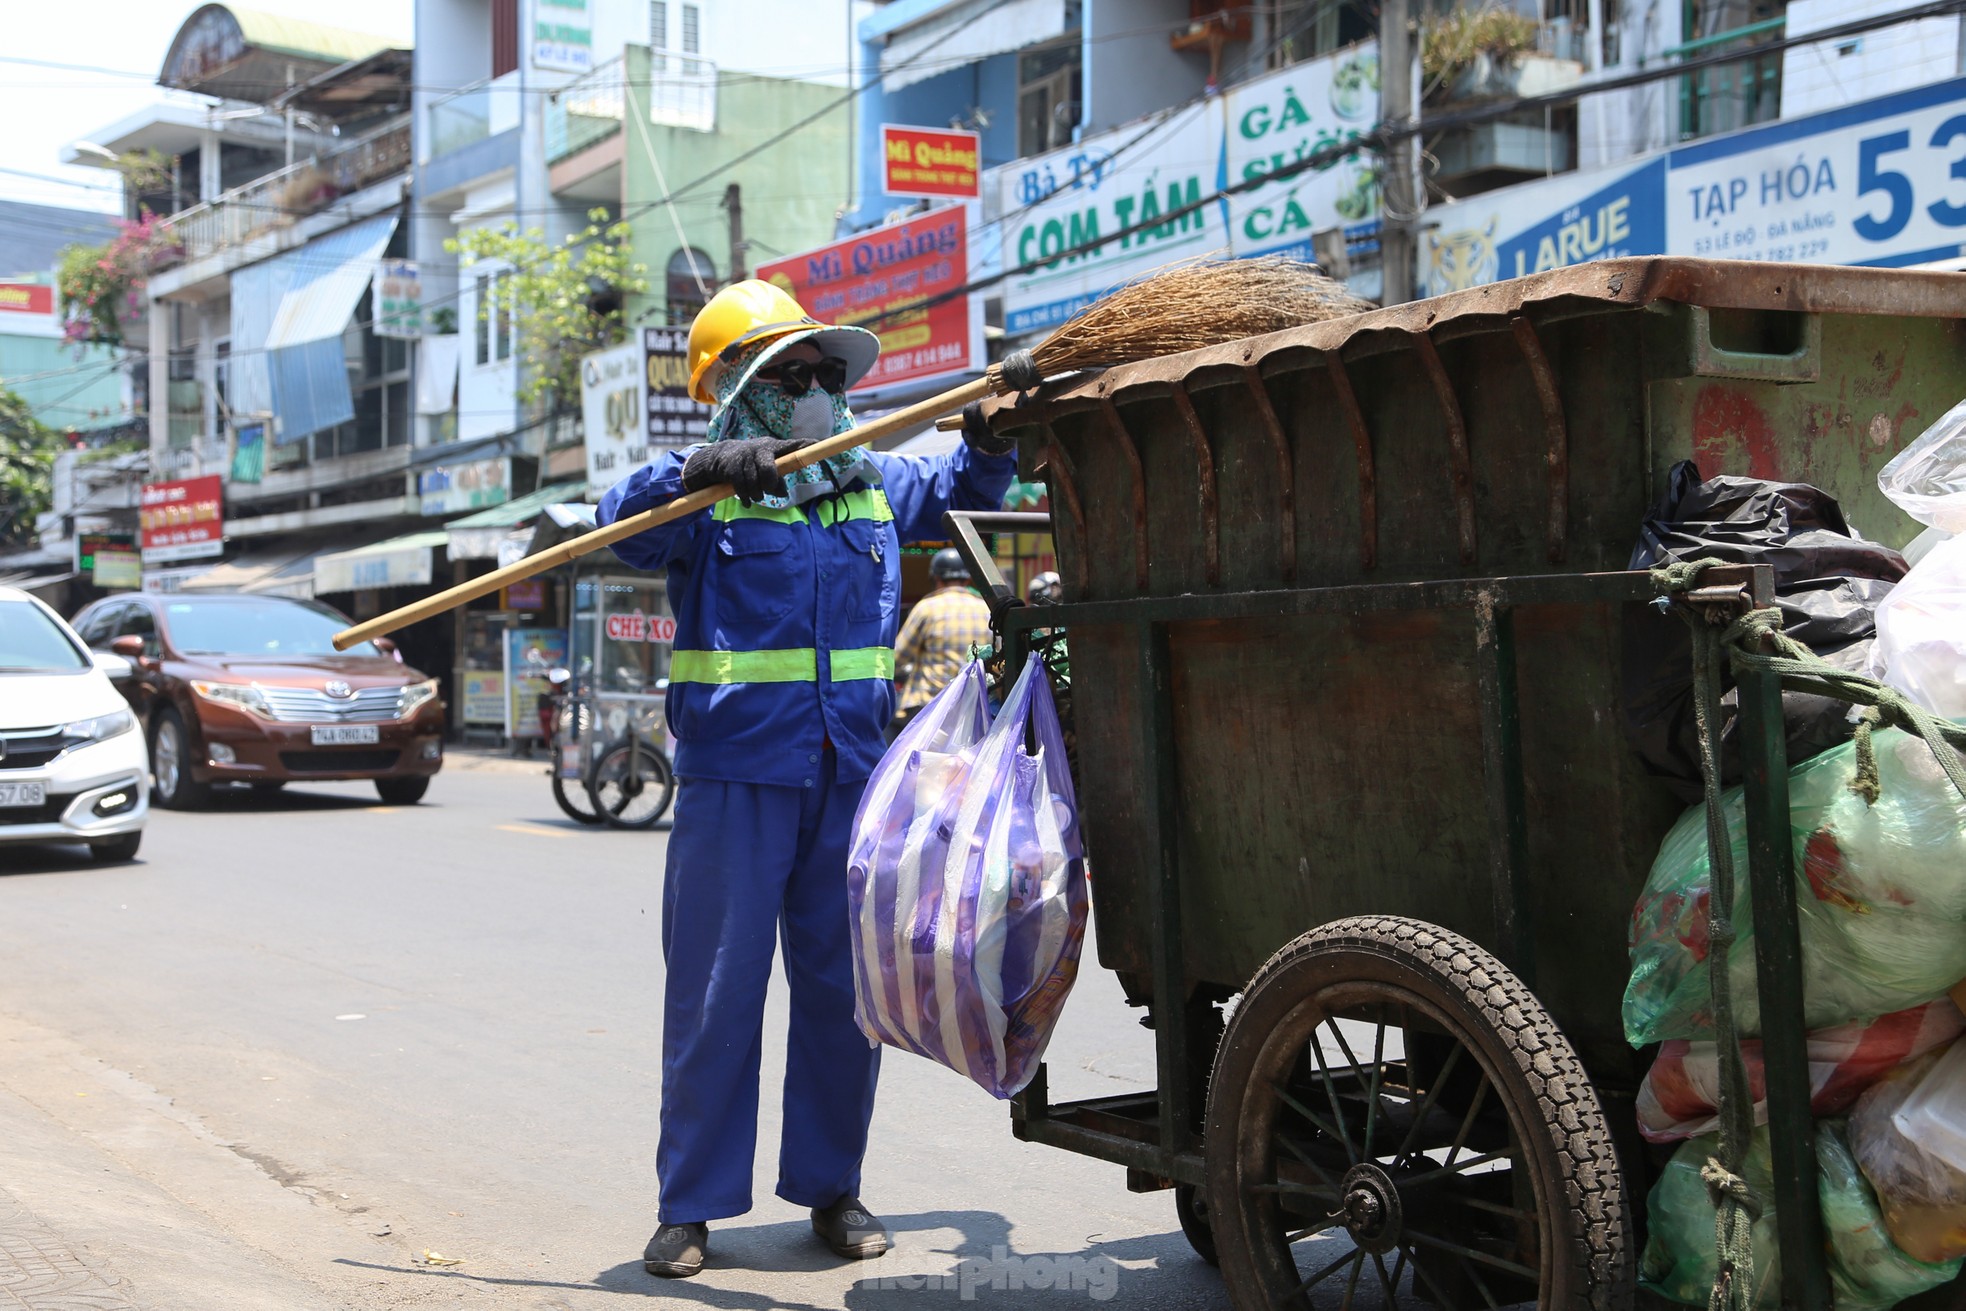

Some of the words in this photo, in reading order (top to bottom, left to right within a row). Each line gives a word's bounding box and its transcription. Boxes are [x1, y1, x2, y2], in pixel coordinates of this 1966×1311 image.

[1240, 86, 1311, 139] GÀ
[915, 141, 976, 172] Quảng
[1853, 113, 1966, 242] 53
[1022, 165, 1057, 206] Bà
[1689, 177, 1747, 228] TẠP
[1761, 153, 1836, 207] HÓA
[1018, 206, 1103, 276] CƠM
[1115, 167, 1204, 250] TẤM
[1243, 189, 1312, 240] CÁ
[808, 252, 841, 286] Mì
[852, 221, 958, 275] Quảng
[606, 608, 646, 641] CHÈ
